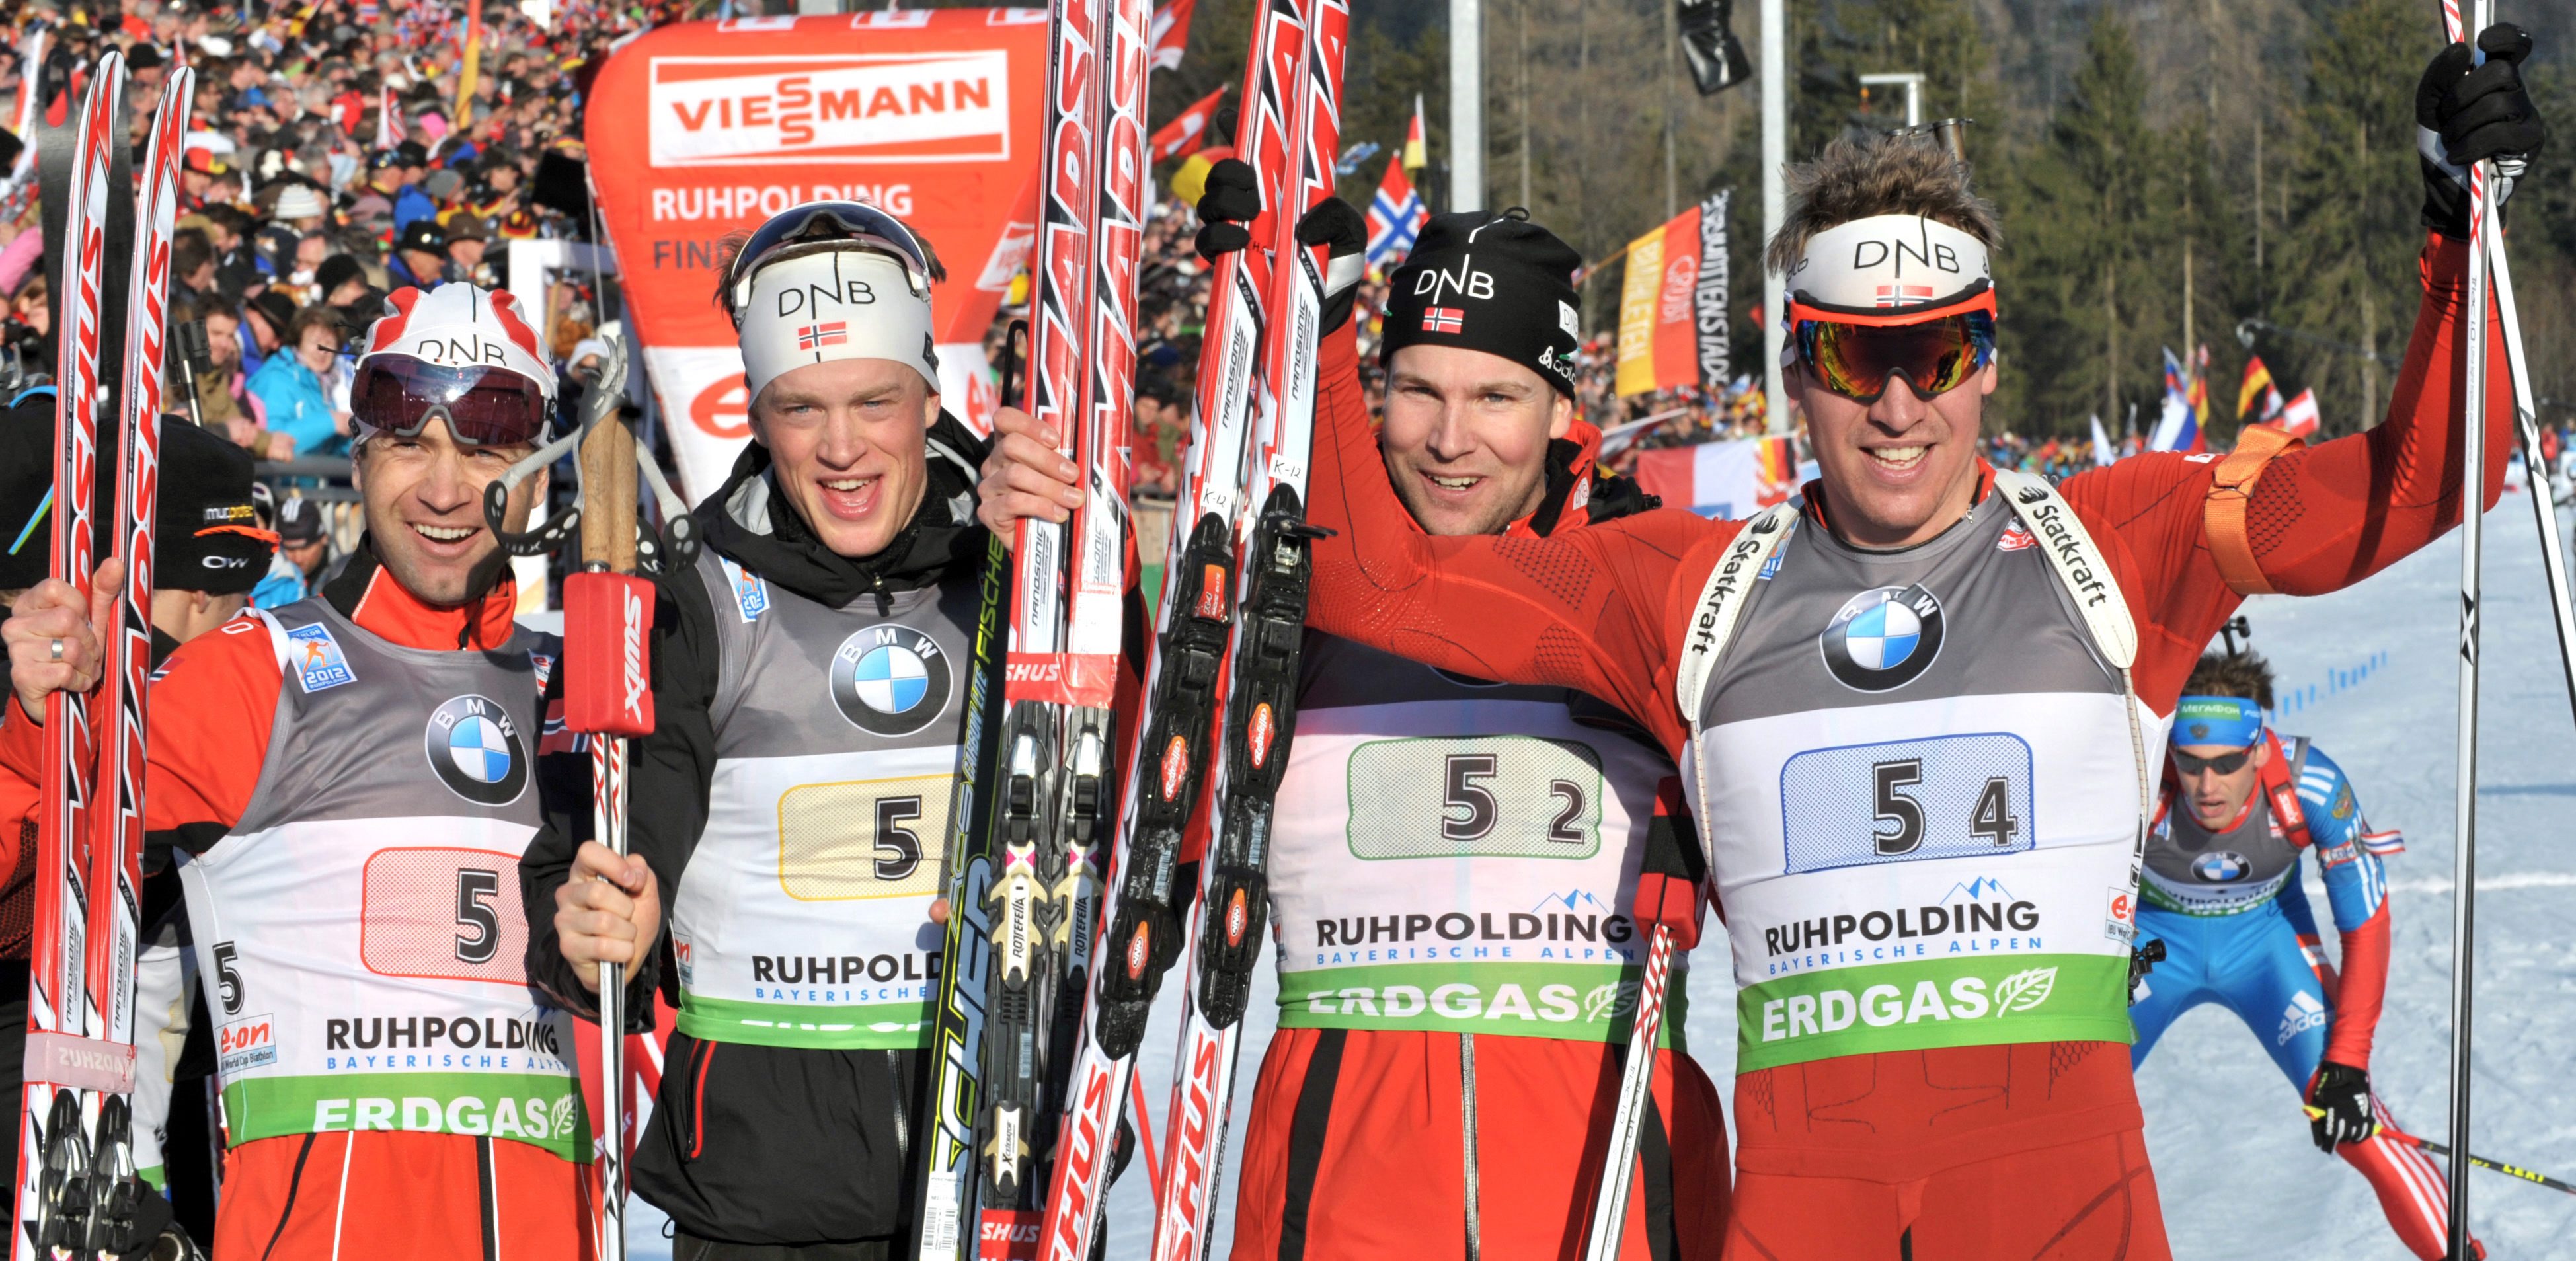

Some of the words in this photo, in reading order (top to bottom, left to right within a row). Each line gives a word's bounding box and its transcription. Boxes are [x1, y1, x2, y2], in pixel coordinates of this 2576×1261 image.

[671, 77, 990, 145] VIESSMANN
[1854, 228, 1960, 280] DNB
[778, 264, 877, 321] DNB
[1414, 258, 1494, 304] DNB
[2032, 505, 2107, 607] Statkraft
[976, 533, 1005, 664] FISCHE
[1691, 540, 1761, 656] Statkraft
[840, 627, 937, 665] BMW
[306, 668, 346, 685] 2012
[435, 698, 514, 739] BMW
[962, 710, 984, 783] CARBON
[974, 661, 989, 715] LITE
[1441, 754, 1498, 841] 5
[1548, 779, 1586, 845] 2
[1873, 758, 1926, 857] 5
[1969, 777, 2018, 847] 4
[874, 795, 923, 880] 5
[455, 868, 500, 964] 5
[1316, 912, 1632, 947] RUHPOLDING
[1765, 899, 2039, 958] RUHPOLDING
[212, 941, 245, 1014] 5
[752, 952, 943, 984] RUHPOLD
[1317, 946, 1512, 965] BAYERISCHE
[1541, 946, 1635, 962] ALPEN
[1770, 943, 1924, 975] BAYERISCHE
[1949, 937, 2041, 954] ALPEN
[756, 987, 927, 1002] BAYERISCHE
[1307, 983, 1579, 1021] ERDGAS
[1762, 977, 1989, 1042] ERDGAS
[327, 1017, 559, 1054] RUHPOLDING
[328, 1054, 508, 1069] BAYERISCHE
[527, 1057, 570, 1072] ALPEN
[313, 1097, 548, 1138] ERDGAS
[2503, 1163, 2544, 1183] LEKI
